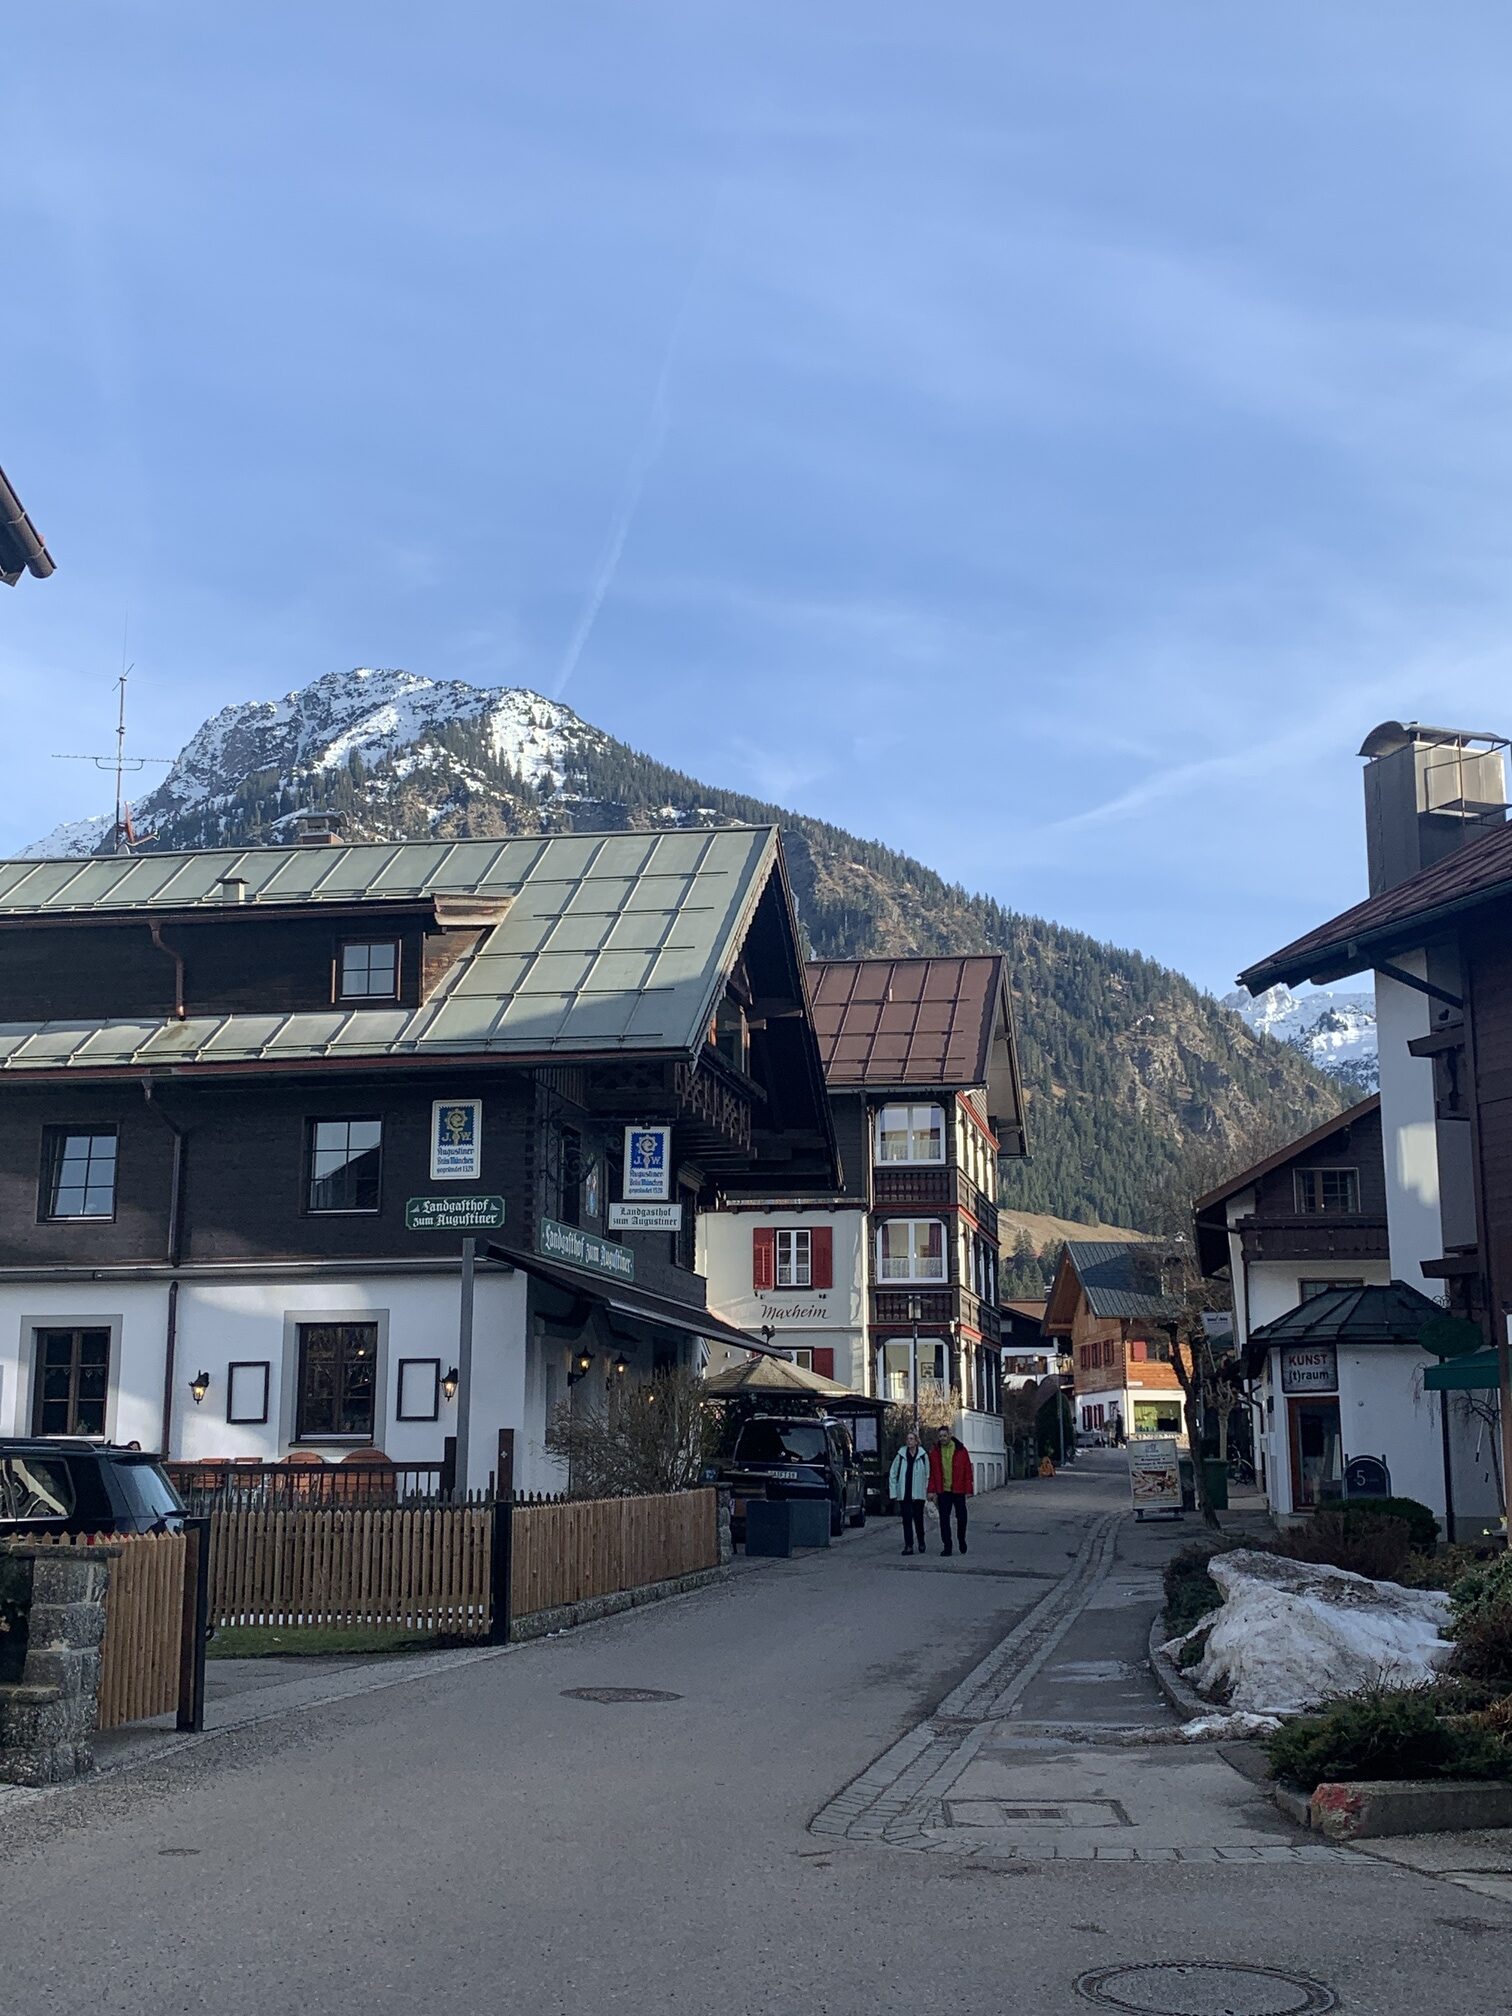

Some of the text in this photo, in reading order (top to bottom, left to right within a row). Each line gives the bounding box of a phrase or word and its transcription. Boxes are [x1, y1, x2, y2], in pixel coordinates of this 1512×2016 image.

[620, 1206, 671, 1217] Landgasthof
[412, 1217, 434, 1228] zum
[612, 1215, 677, 1227] zum Augustiner
[585, 1243, 600, 1264] zum
[761, 1304, 832, 1320] Maxheim
[1289, 1354, 1328, 1366] KUNST
[1356, 1469, 1366, 1487] 5
